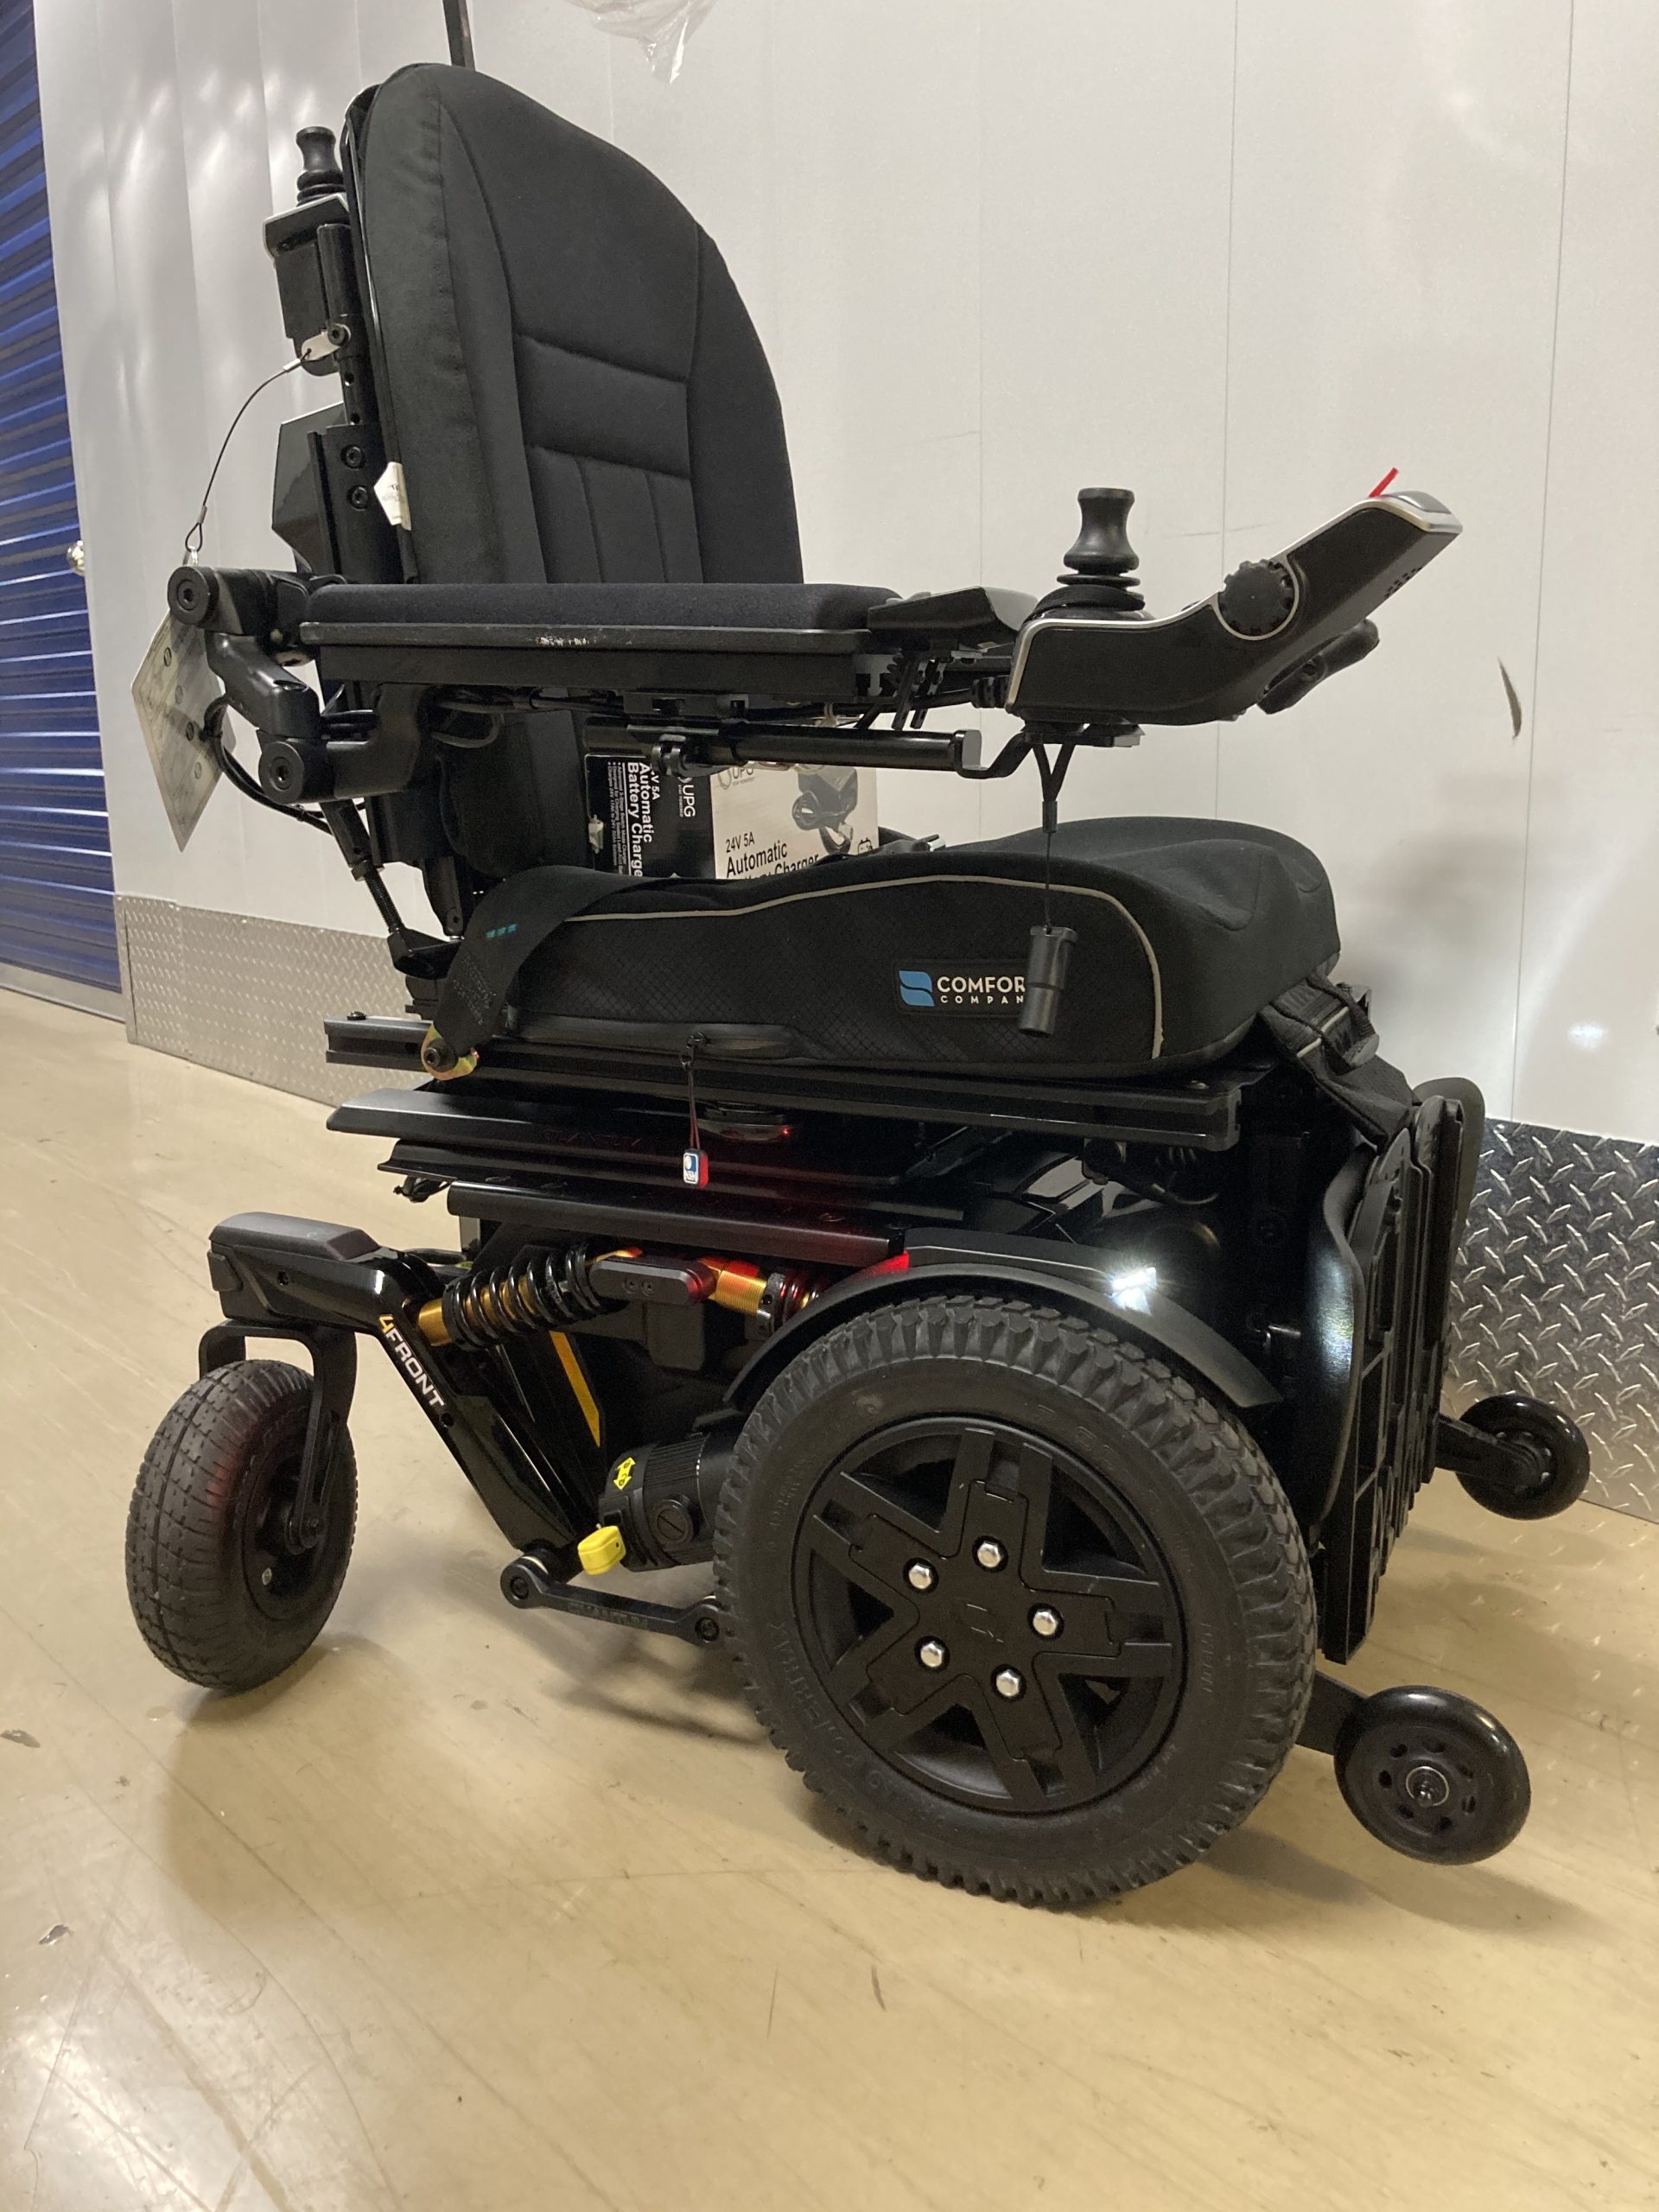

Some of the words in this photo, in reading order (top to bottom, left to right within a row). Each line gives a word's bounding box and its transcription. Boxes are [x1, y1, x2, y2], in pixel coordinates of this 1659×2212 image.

[627, 762, 640, 818] Battery
[639, 762, 655, 842] Automatic
[652, 785, 661, 800] 5A
[683, 785, 696, 817] UPG
[631, 823, 644, 877] Charge
[726, 835, 741, 854] 24V
[743, 831, 755, 848] 5A
[726, 839, 788, 879] Automatic
[937, 976, 1026, 993] COMFOR
[940, 995, 1024, 1004] COMPAN
[378, 1313, 446, 1407] 4FRONT
